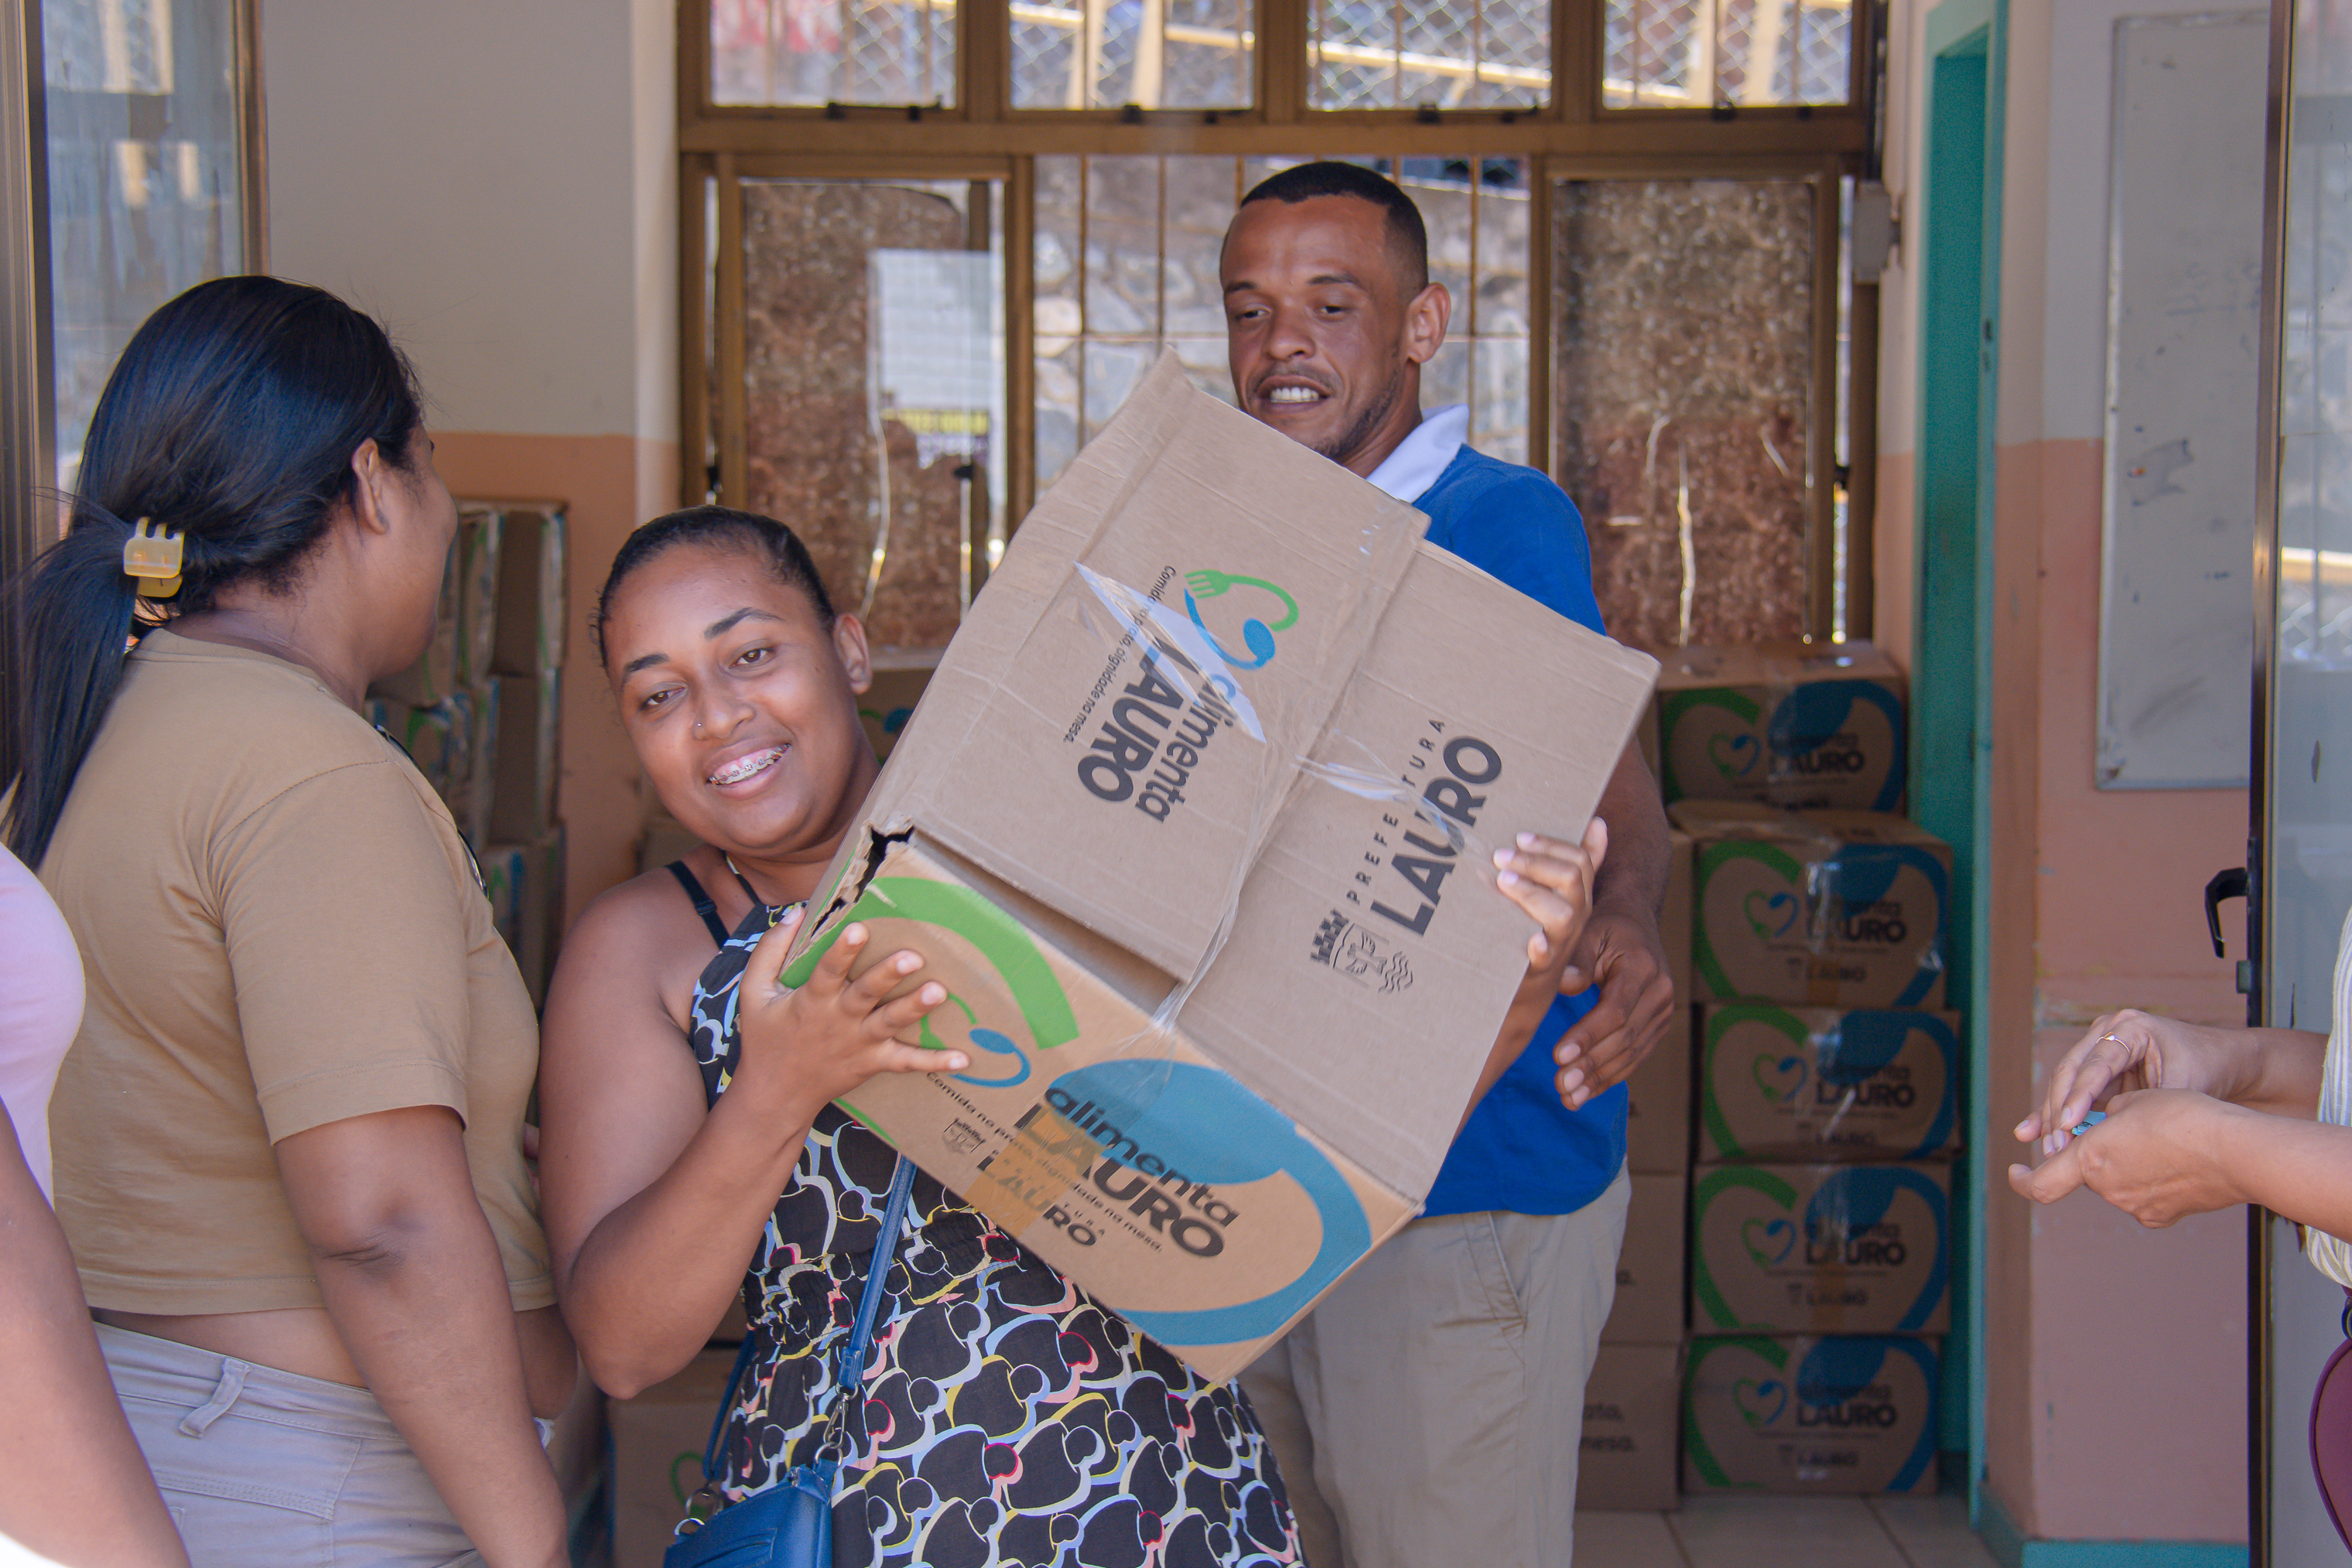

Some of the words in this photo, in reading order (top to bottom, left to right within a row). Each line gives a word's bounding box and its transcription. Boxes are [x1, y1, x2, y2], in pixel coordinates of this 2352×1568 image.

[1147, 565, 1178, 606] Comida
[1062, 712, 1088, 745] mesa.
[1077, 635, 1200, 803] LAURO
[1082, 697, 1098, 716] na
[1089, 646, 1128, 702] dignidade
[1135, 673, 1237, 823] alimenta
[1345, 719, 1445, 905] PREFETURA
[1369, 736, 1502, 936] LAURO
[1817, 1082, 1916, 1108] LAURO
[925, 1070, 978, 1115] Comida
[975, 1111, 996, 1129] no
[1103, 1207, 1125, 1225] na
[1123, 1221, 1162, 1252] mesa.
[976, 1155, 1097, 1247] LAURO
[1014, 1102, 1226, 1259] LAURO
[1044, 1087, 1239, 1228] alimenta
[1797, 1403, 1896, 1427] LAURO
